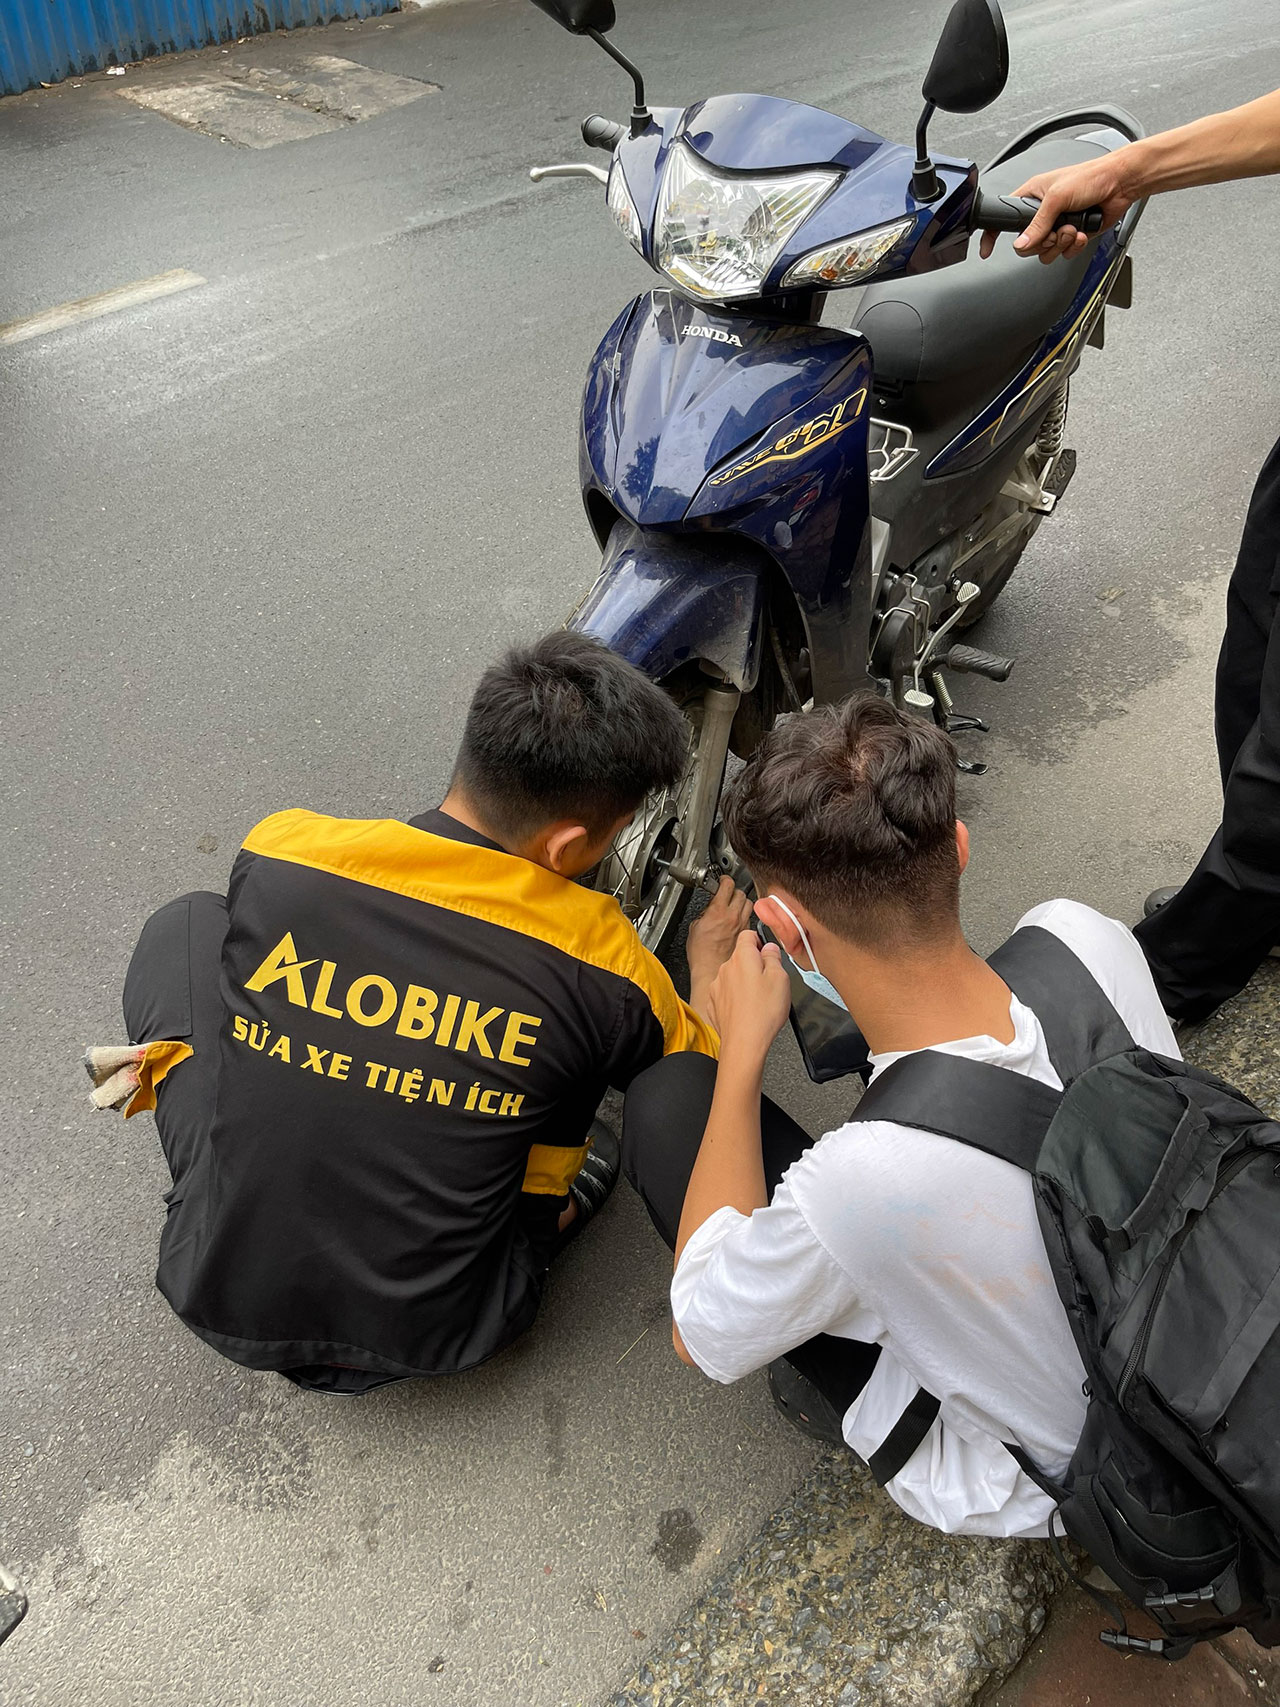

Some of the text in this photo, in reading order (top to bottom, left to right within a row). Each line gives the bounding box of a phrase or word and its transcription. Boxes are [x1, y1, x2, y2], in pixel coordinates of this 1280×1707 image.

[681, 325, 743, 347] HONDA
[244, 931, 543, 1067] ALOBIKE
[232, 1015, 526, 1117] SỬA XE TIỆN ÍCH
